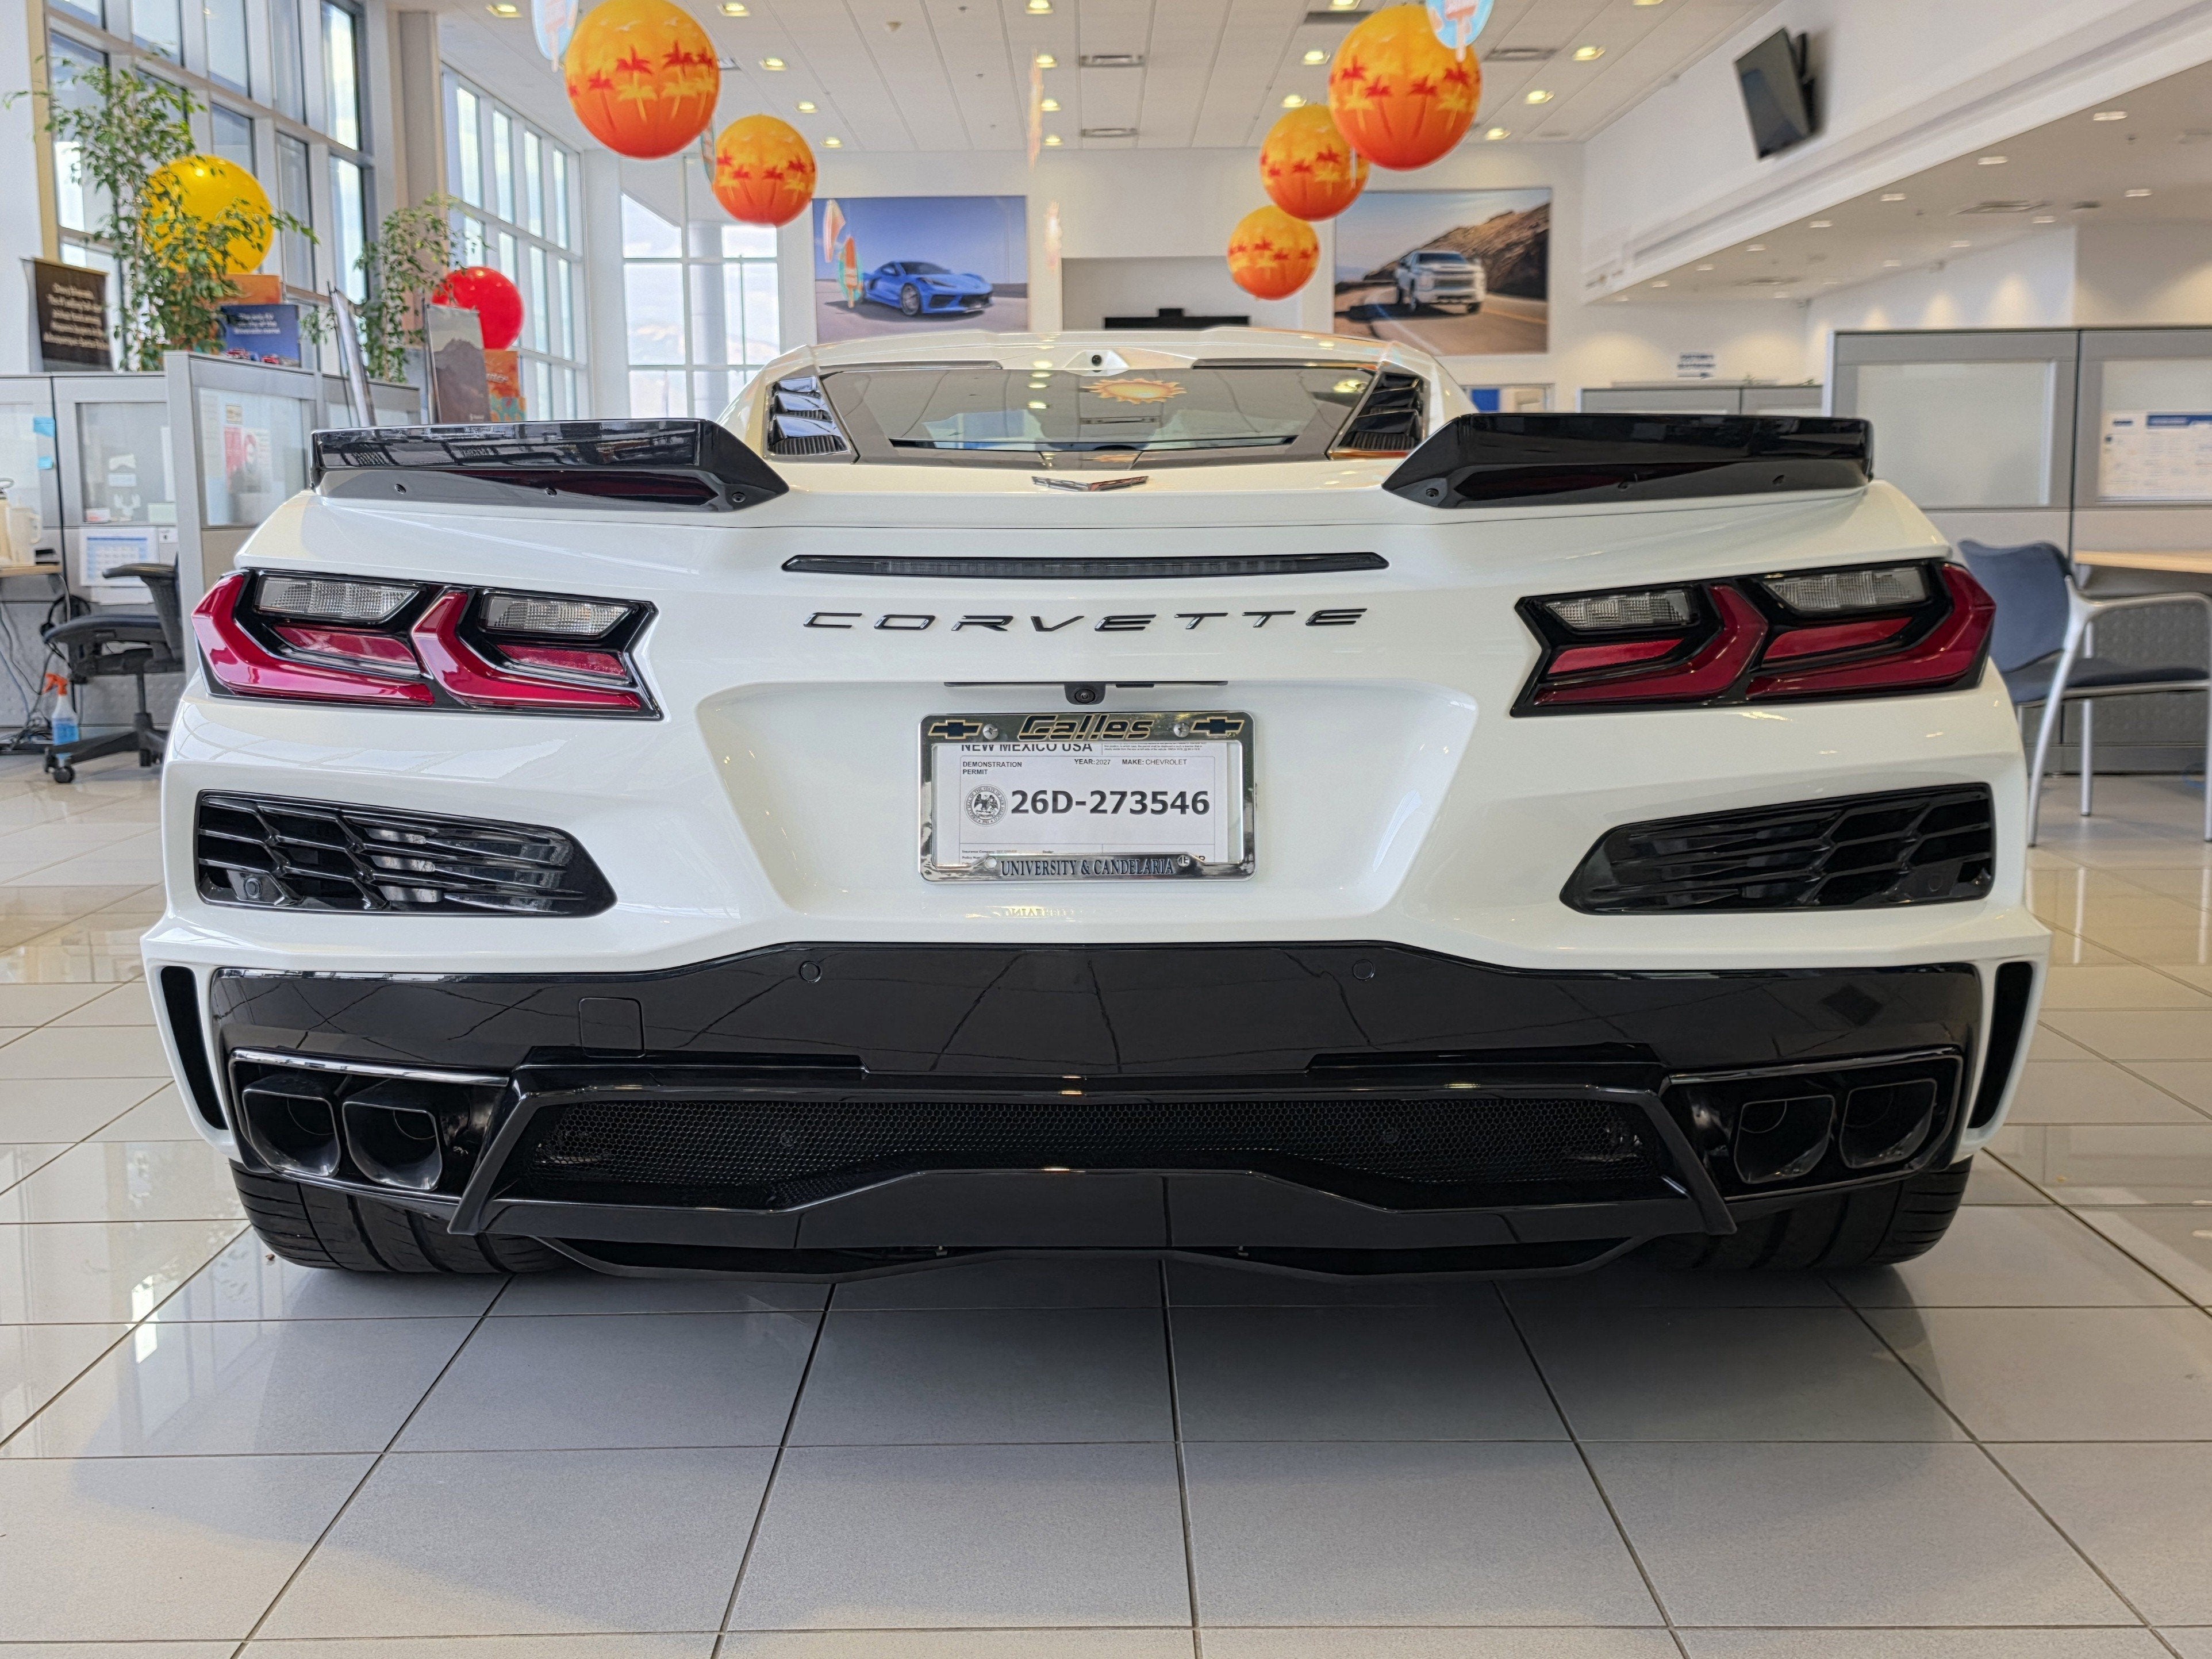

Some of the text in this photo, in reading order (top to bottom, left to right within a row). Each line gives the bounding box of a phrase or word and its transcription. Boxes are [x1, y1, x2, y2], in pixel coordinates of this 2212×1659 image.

[803, 608, 1368, 632] CORVETTE
[1017, 714, 1154, 741] Galles
[961, 743, 1093, 752] NEW MEXICO USA
[1011, 790, 1210, 815] 26D-273546
[1001, 860, 1077, 876] UNIVERSITY
[1081, 860, 1090, 875] &
[1093, 859, 1175, 875] CANDELARIA
